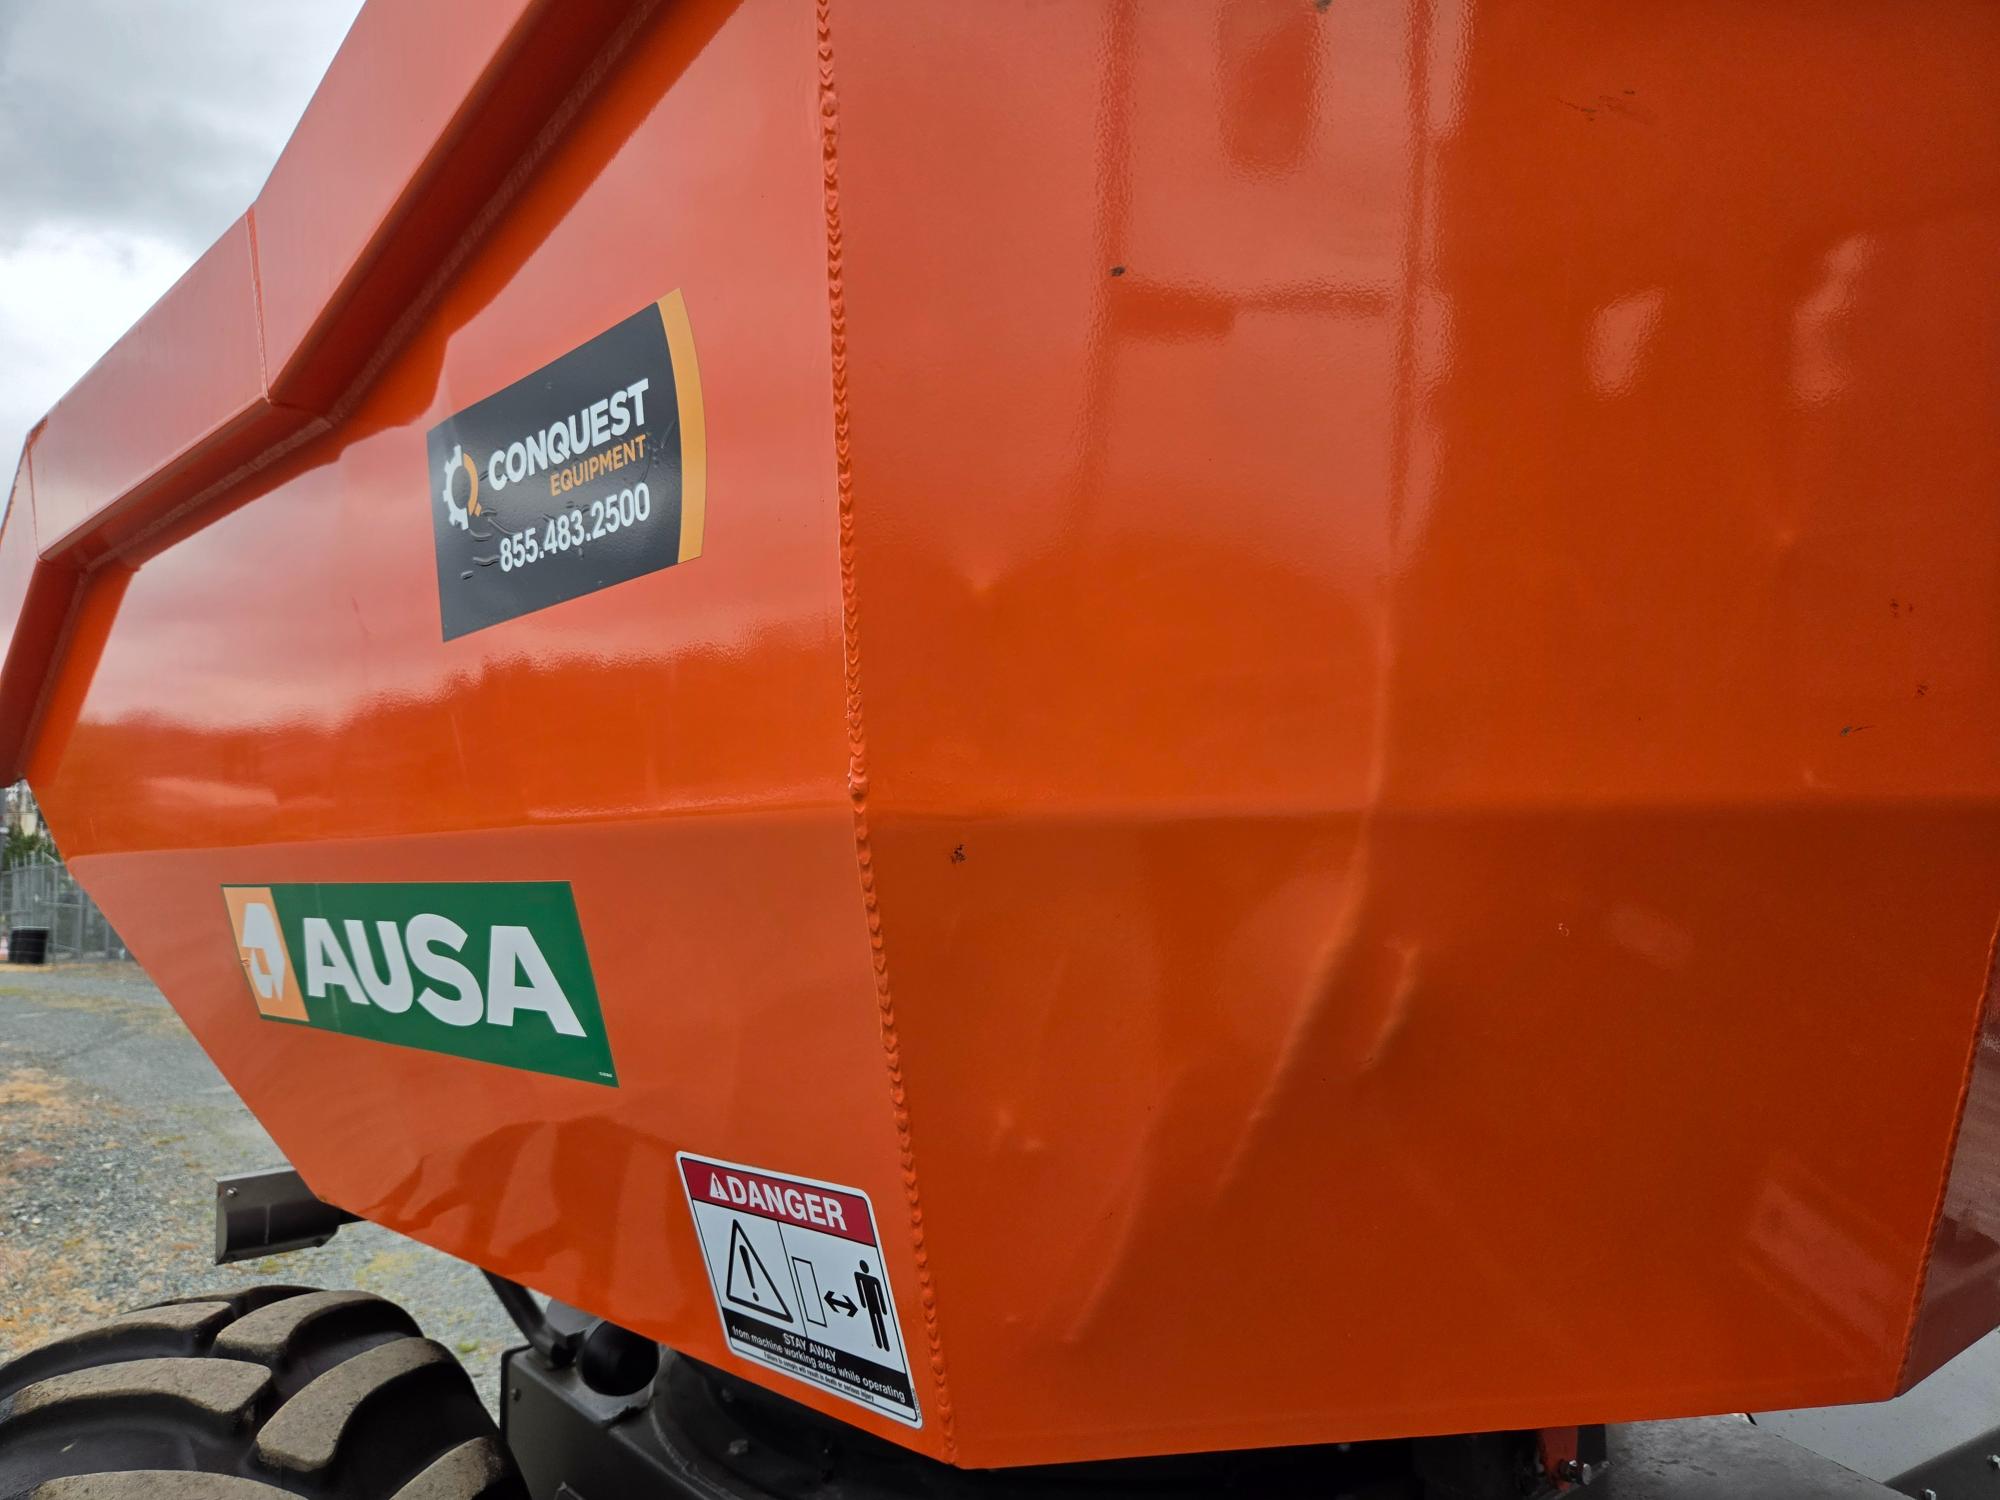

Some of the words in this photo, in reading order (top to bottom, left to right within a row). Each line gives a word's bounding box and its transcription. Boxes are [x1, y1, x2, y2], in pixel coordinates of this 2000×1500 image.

[488, 377, 649, 491] CONQUEST
[550, 433, 646, 497] EQUIPMENT
[499, 481, 651, 573] 855.483.2500
[303, 912, 588, 1038] AUSA
[726, 1175, 848, 1232] DANGER
[732, 1325, 751, 1341] from
[751, 1332, 783, 1353] machine
[784, 1347, 817, 1369] working
[817, 1360, 837, 1374] area
[838, 1367, 861, 1384] while
[862, 1377, 906, 1403] operating
[782, 1332, 806, 1351] STAY
[808, 1343, 836, 1362] AWAY
